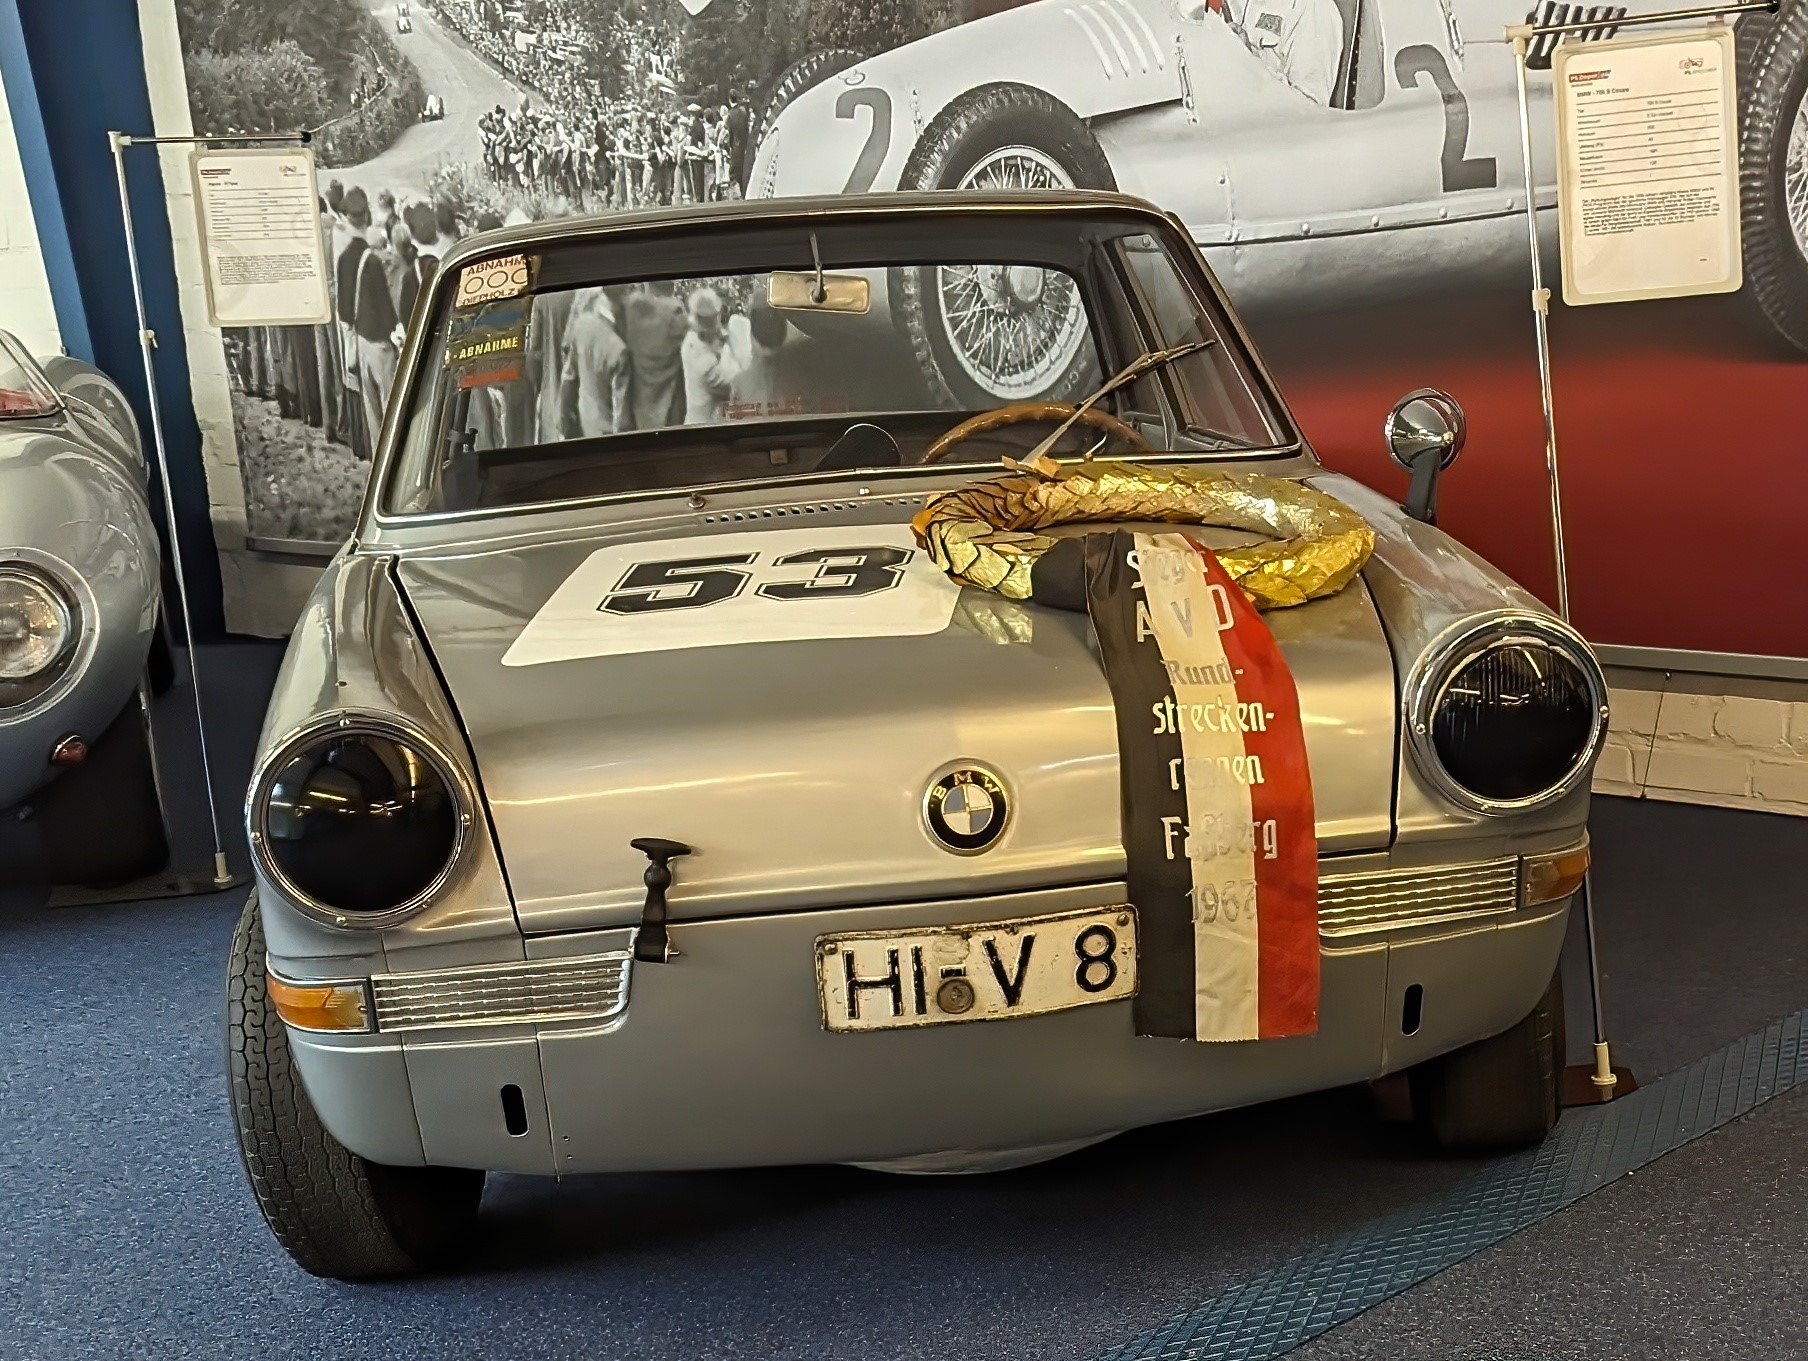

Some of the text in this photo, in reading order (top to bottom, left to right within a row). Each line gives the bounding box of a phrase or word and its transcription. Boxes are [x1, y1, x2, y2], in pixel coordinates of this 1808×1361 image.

[835, 87, 892, 195] 2
[1394, 45, 1497, 192] 2
[596, 545, 915, 616] 53
[1160, 657, 1244, 686] Rund-
[1152, 695, 1275, 735] strecken-
[932, 770, 1001, 800] BMW
[1074, 924, 1118, 993] 8
